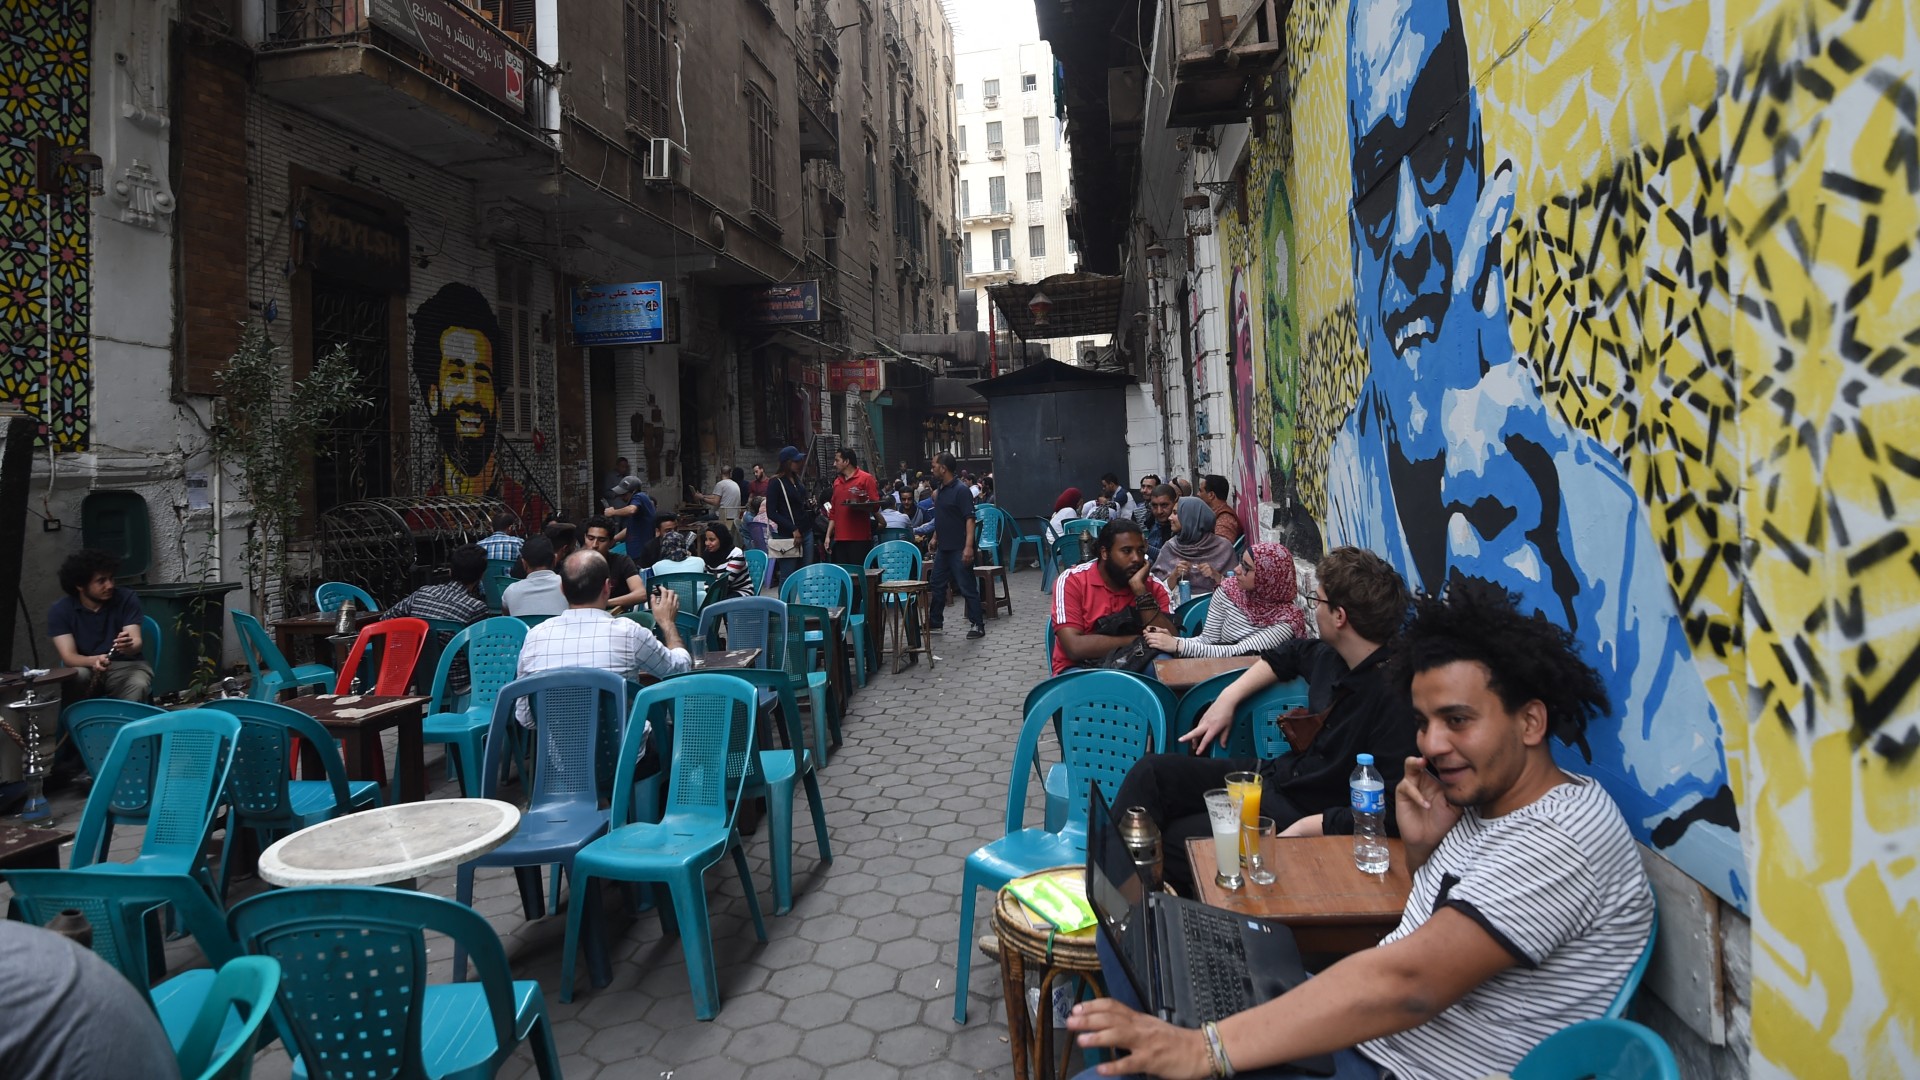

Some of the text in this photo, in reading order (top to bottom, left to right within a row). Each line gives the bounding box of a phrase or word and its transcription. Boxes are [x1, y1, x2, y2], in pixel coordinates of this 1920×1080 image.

[412, 3, 443, 30] التوزيع
[445, 24, 451, 39] و
[454, 27, 475, 51] للنشر
[631, 287, 657, 297] جمعة
